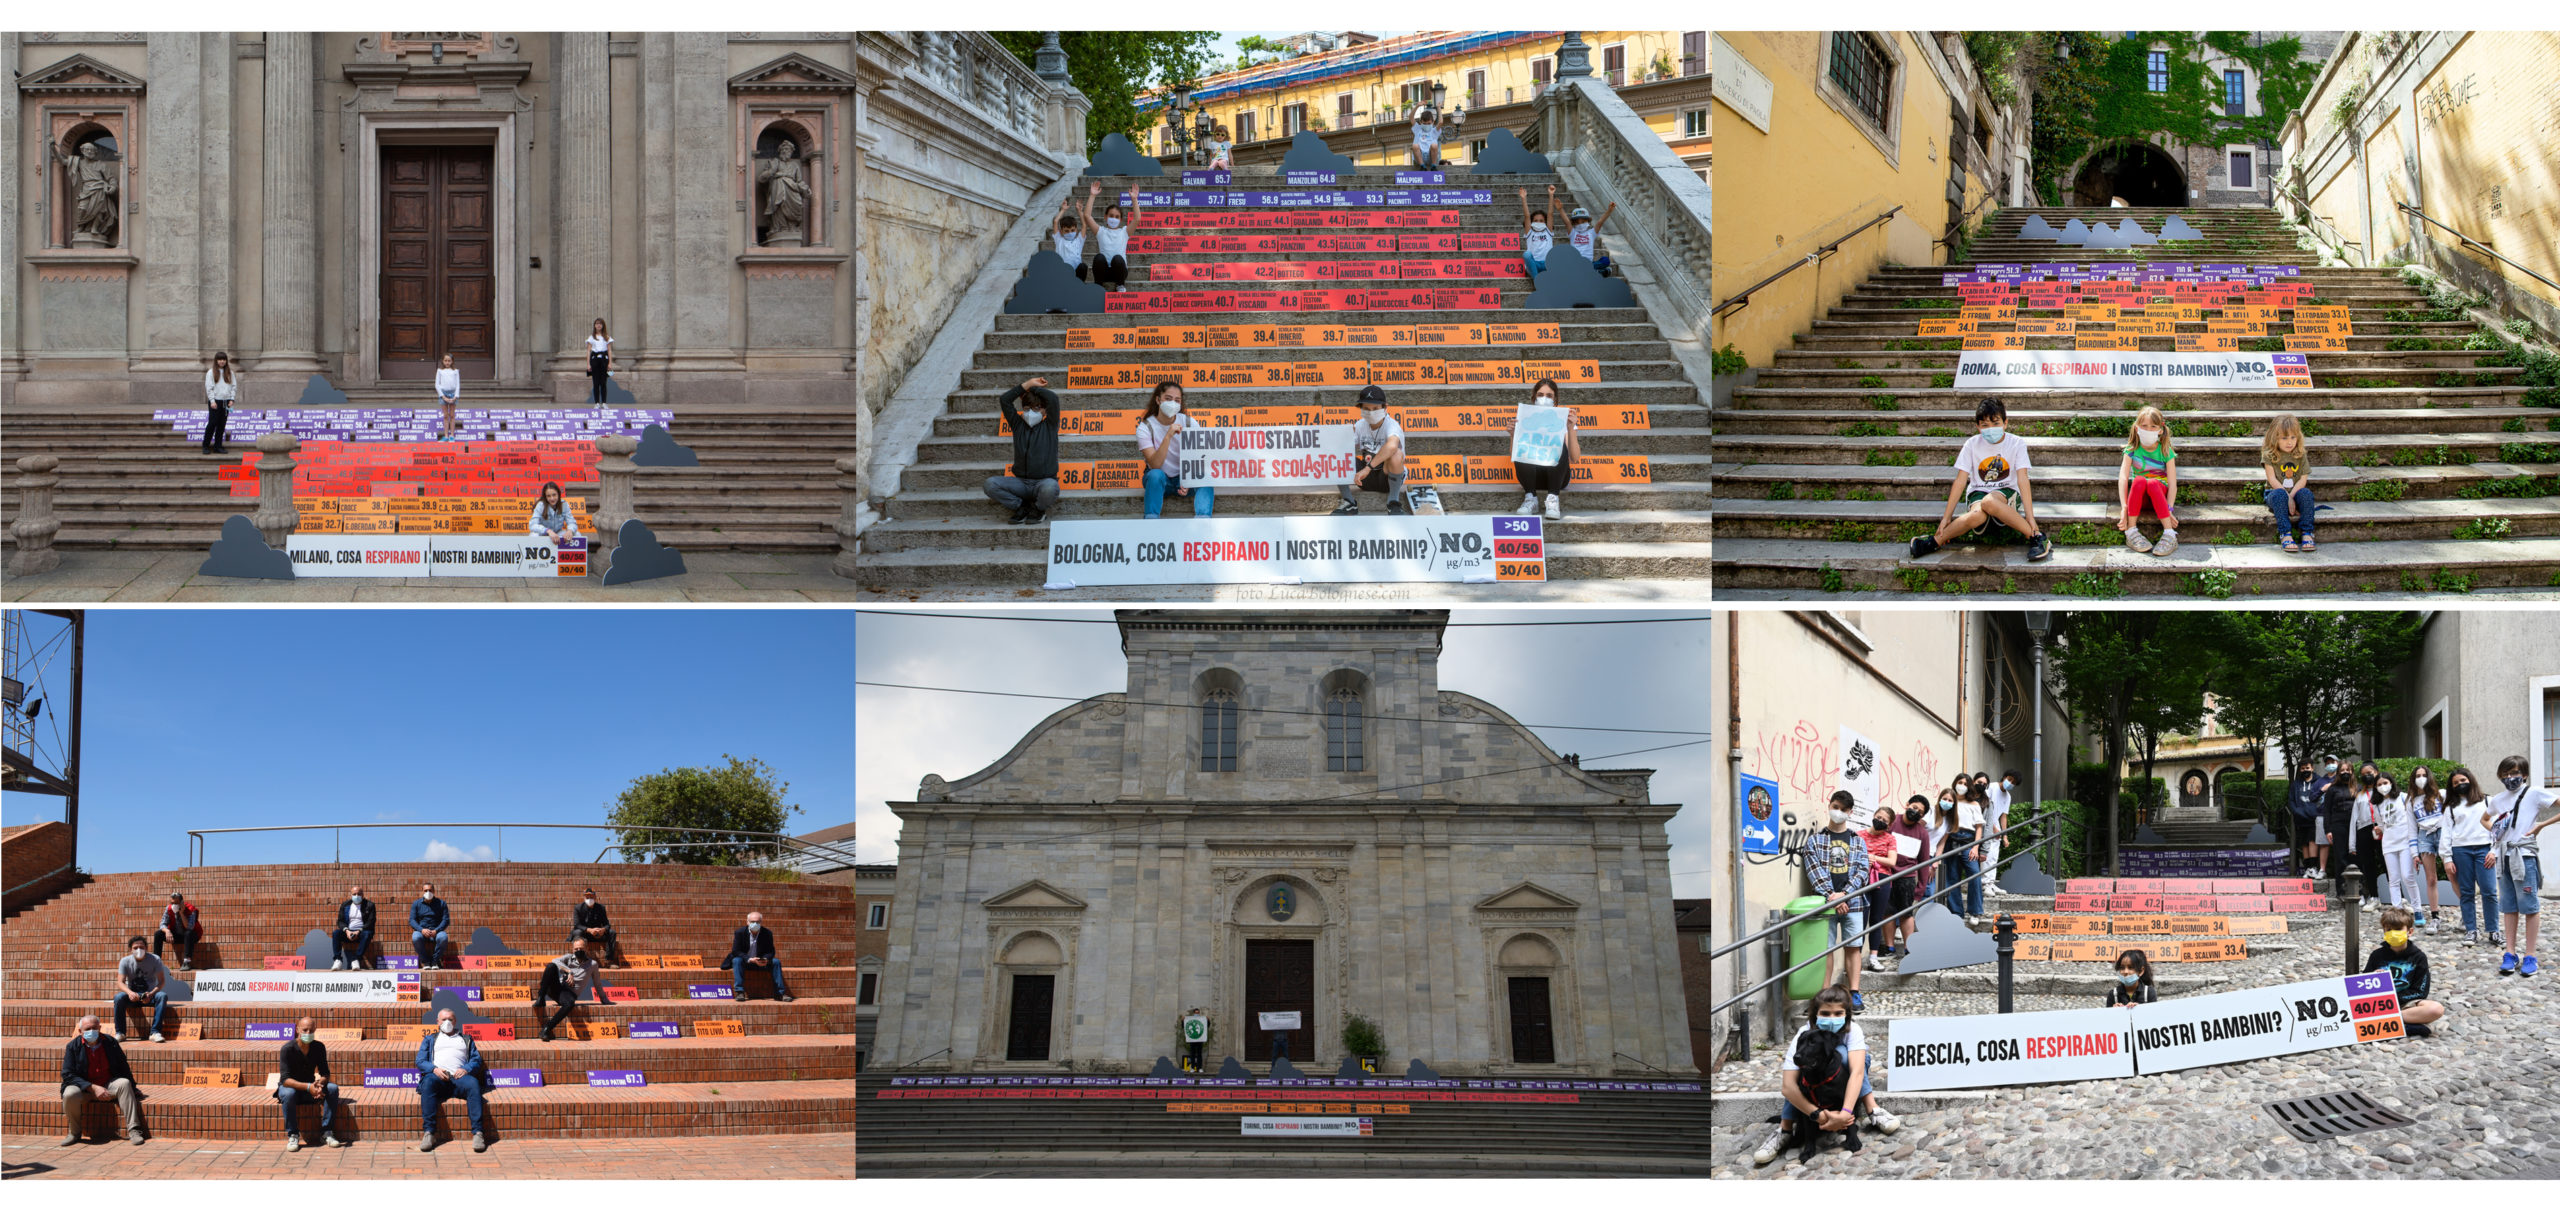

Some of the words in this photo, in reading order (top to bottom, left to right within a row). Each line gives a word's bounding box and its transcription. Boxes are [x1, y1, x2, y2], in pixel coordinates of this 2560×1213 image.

[1215, 174, 1231, 184] 65.7
[1434, 174, 1443, 183] 63
[1403, 268, 1437, 277] TEMPESTA
[1148, 297, 1168, 308] 40.5
[1411, 293, 1432, 305] 40.5
[1997, 309, 2016, 319] 34.8
[2182, 308, 2201, 318] 33.9
[1957, 323, 1975, 332] 34.1
[2017, 325, 2047, 333] BOCCIONI
[2055, 322, 2073, 332] 32.1
[2155, 321, 2174, 332] 37.7
[2247, 321, 2266, 332] 38.7
[2296, 325, 2329, 334] TEMPESTA
[2337, 321, 2348, 332] 34
[1138, 336, 1169, 346] MARSILI
[1182, 332, 1204, 343] 39.3
[1347, 333, 1378, 343] IRNERIO
[1392, 330, 1414, 341] 39.7
[1418, 332, 1445, 342] BENINI
[1470, 329, 1482, 340] 39
[1491, 332, 1527, 342] GANDINO
[1537, 328, 1559, 339] 39.2
[1964, 339, 1995, 348] AUGUSTO
[2004, 337, 2025, 346] 38.3
[2118, 337, 2138, 347] 34.8
[2177, 338, 2197, 346] MANIN
[2217, 337, 2237, 348] 37.8
[2326, 338, 2345, 348] 38.2
[2280, 355, 2298, 363] >50
[1295, 372, 1324, 383] HYGEIA
[1343, 367, 1366, 380] 38.3
[1372, 372, 1384, 382] DE
[1386, 371, 1415, 382] AMICIS
[1420, 366, 1444, 379] 38.2
[1449, 373, 1464, 382] DON
[1465, 373, 1495, 381] MINZONI
[1497, 366, 1521, 379] 38.9
[1526, 370, 1571, 380] PELLICANO
[1580, 366, 1594, 378] 38
[1961, 362, 2001, 377] ROMA,
[2006, 362, 2037, 375] COSA
[2041, 362, 2108, 376] RESPIRANO
[2112, 363, 2116, 375] I
[2120, 363, 2164, 376] NOSTRI
[2167, 363, 2228, 377] BAMBINI?
[2277, 366, 2307, 375] 40/50
[1070, 375, 1114, 386] PRIMAVERA
[1117, 371, 1140, 383] 38.5
[1145, 374, 1183, 384] GIORDANI
[1193, 370, 1216, 382] 38.4
[1219, 373, 1253, 384] GIOSTRA
[1267, 369, 1290, 381] 38.6
[2279, 378, 2309, 386] 30/40
[1215, 415, 1237, 427] 38.1
[1406, 417, 1439, 429] CAVINA
[1458, 412, 1482, 426] 38.3
[1621, 411, 1645, 425] 37.1
[1083, 420, 1104, 432] ACRI
[1181, 430, 1226, 451] MENO
[1228, 427, 1320, 450] AUTOSTRADE
[1518, 432, 1561, 447] ARIA
[1516, 444, 1560, 463] PESA
[1211, 458, 1266, 479] STRADE
[1272, 452, 1354, 480] SCOLASTICHE
[1435, 463, 1462, 478] 36.8
[1619, 463, 1648, 478] 36.6
[1062, 470, 1090, 484] 36.8
[1096, 470, 1140, 481] CASARALTA
[1470, 468, 1514, 480] BOLDRINI
[371, 500, 388, 511] 38.7
[421, 500, 438, 511] 39.9
[470, 500, 486, 510] 28.5
[325, 519, 342, 529] 32.7
[378, 519, 394, 530] 28.5
[433, 519, 450, 530] 34.8
[484, 519, 500, 529] 36.1
[1504, 520, 1529, 532] >50
[1053, 543, 1130, 566] BOLOGNA,
[1137, 542, 1177, 563] COSA
[1183, 540, 1270, 562] RESPIRANO
[1276, 541, 1281, 561] I
[1286, 540, 1343, 561] NOSTRI
[1348, 539, 1428, 561] BAMBINI?
[1498, 542, 1540, 555] 40/50
[290, 550, 333, 566] MILANO,
[337, 550, 362, 565] COSA
[365, 550, 421, 565] RESPIRANO
[424, 551, 428, 565] I
[432, 550, 468, 565] NOSTRI
[471, 550, 522, 566] BAMBINI?
[560, 553, 585, 561] 40/50
[560, 566, 585, 574] 30/40
[1499, 564, 1541, 577] 30/40
[2056, 901, 2081, 909] BATTISTI
[2172, 923, 2209, 933] QUASIMODO
[2213, 920, 2224, 931] 34
[2054, 950, 2074, 959] VILLA
[2194, 950, 2221, 960] SCALVINI
[2224, 944, 2245, 956] 33.4
[196, 981, 225, 994] NAPOLI,
[227, 981, 246, 992] COSA
[248, 981, 290, 992] RESPIRANO
[291, 981, 295, 992] I
[296, 982, 323, 993] NOSTRI
[325, 982, 364, 993] BAMBINI?
[2357, 977, 2382, 992] >50
[2354, 998, 2395, 1015] 40/50
[246, 1029, 280, 1039] KAGOSHIMA
[283, 1027, 293, 1037] 53
[497, 1027, 514, 1038] 48.5
[697, 1027, 708, 1036] TITO
[710, 1027, 724, 1036] LIVIO
[727, 1025, 743, 1034] 32.8
[2358, 1019, 2400, 1037] 30/40
[1895, 1042, 1971, 1068] BRESCIA,
[1977, 1039, 2020, 1062] COSA
[2026, 1033, 2118, 1060] RESPIRANO
[2124, 1032, 2129, 1054] I
[2137, 1022, 2197, 1052] NOSTRI
[2201, 1010, 2283, 1044] BAMBINI?
[185, 1076, 191, 1085] DI
[192, 1076, 208, 1085] CESA
[220, 1072, 238, 1084] 32.2
[365, 1076, 400, 1086] CAMPANIA
[402, 1072, 420, 1084] 68.5
[529, 1073, 540, 1084] 57
